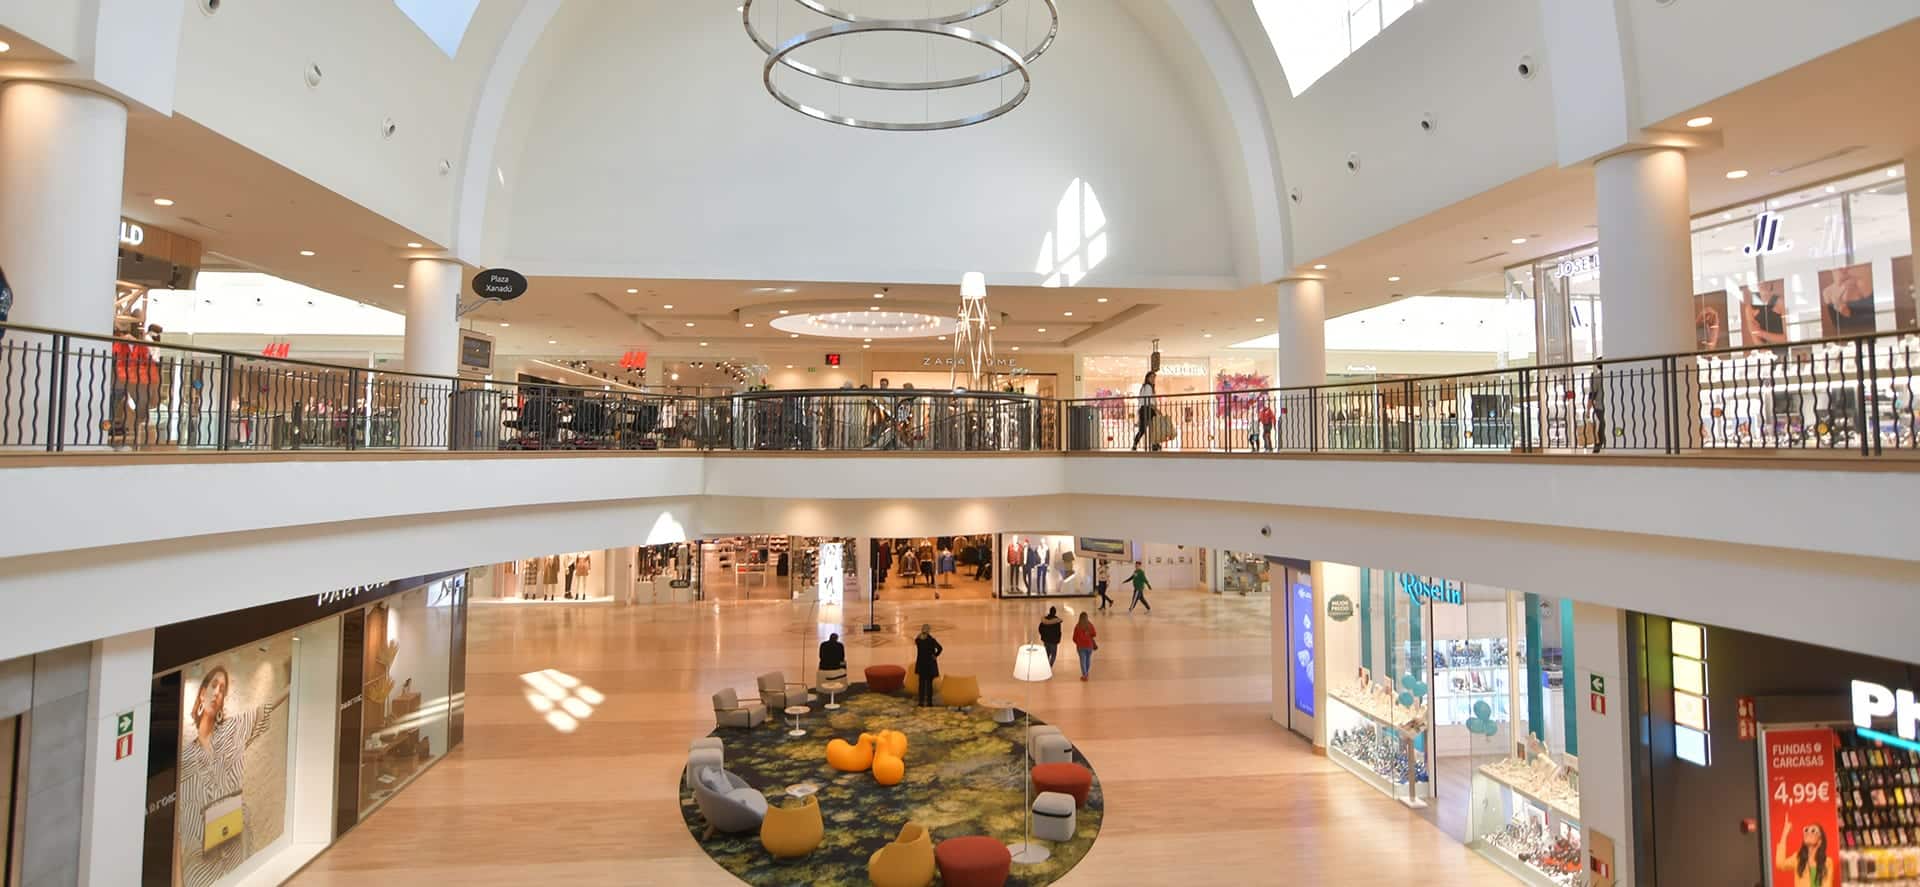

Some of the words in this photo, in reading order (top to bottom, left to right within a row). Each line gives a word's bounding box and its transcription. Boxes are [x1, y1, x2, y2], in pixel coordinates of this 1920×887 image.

[490, 274, 510, 283] Plaza
[922, 357, 965, 366] ZARA
[1399, 573, 1464, 607] Roselin
[1773, 744, 1812, 756] FUNDAS
[1773, 755, 1825, 768] CARCASAS
[1774, 781, 1830, 807] 4,99€
